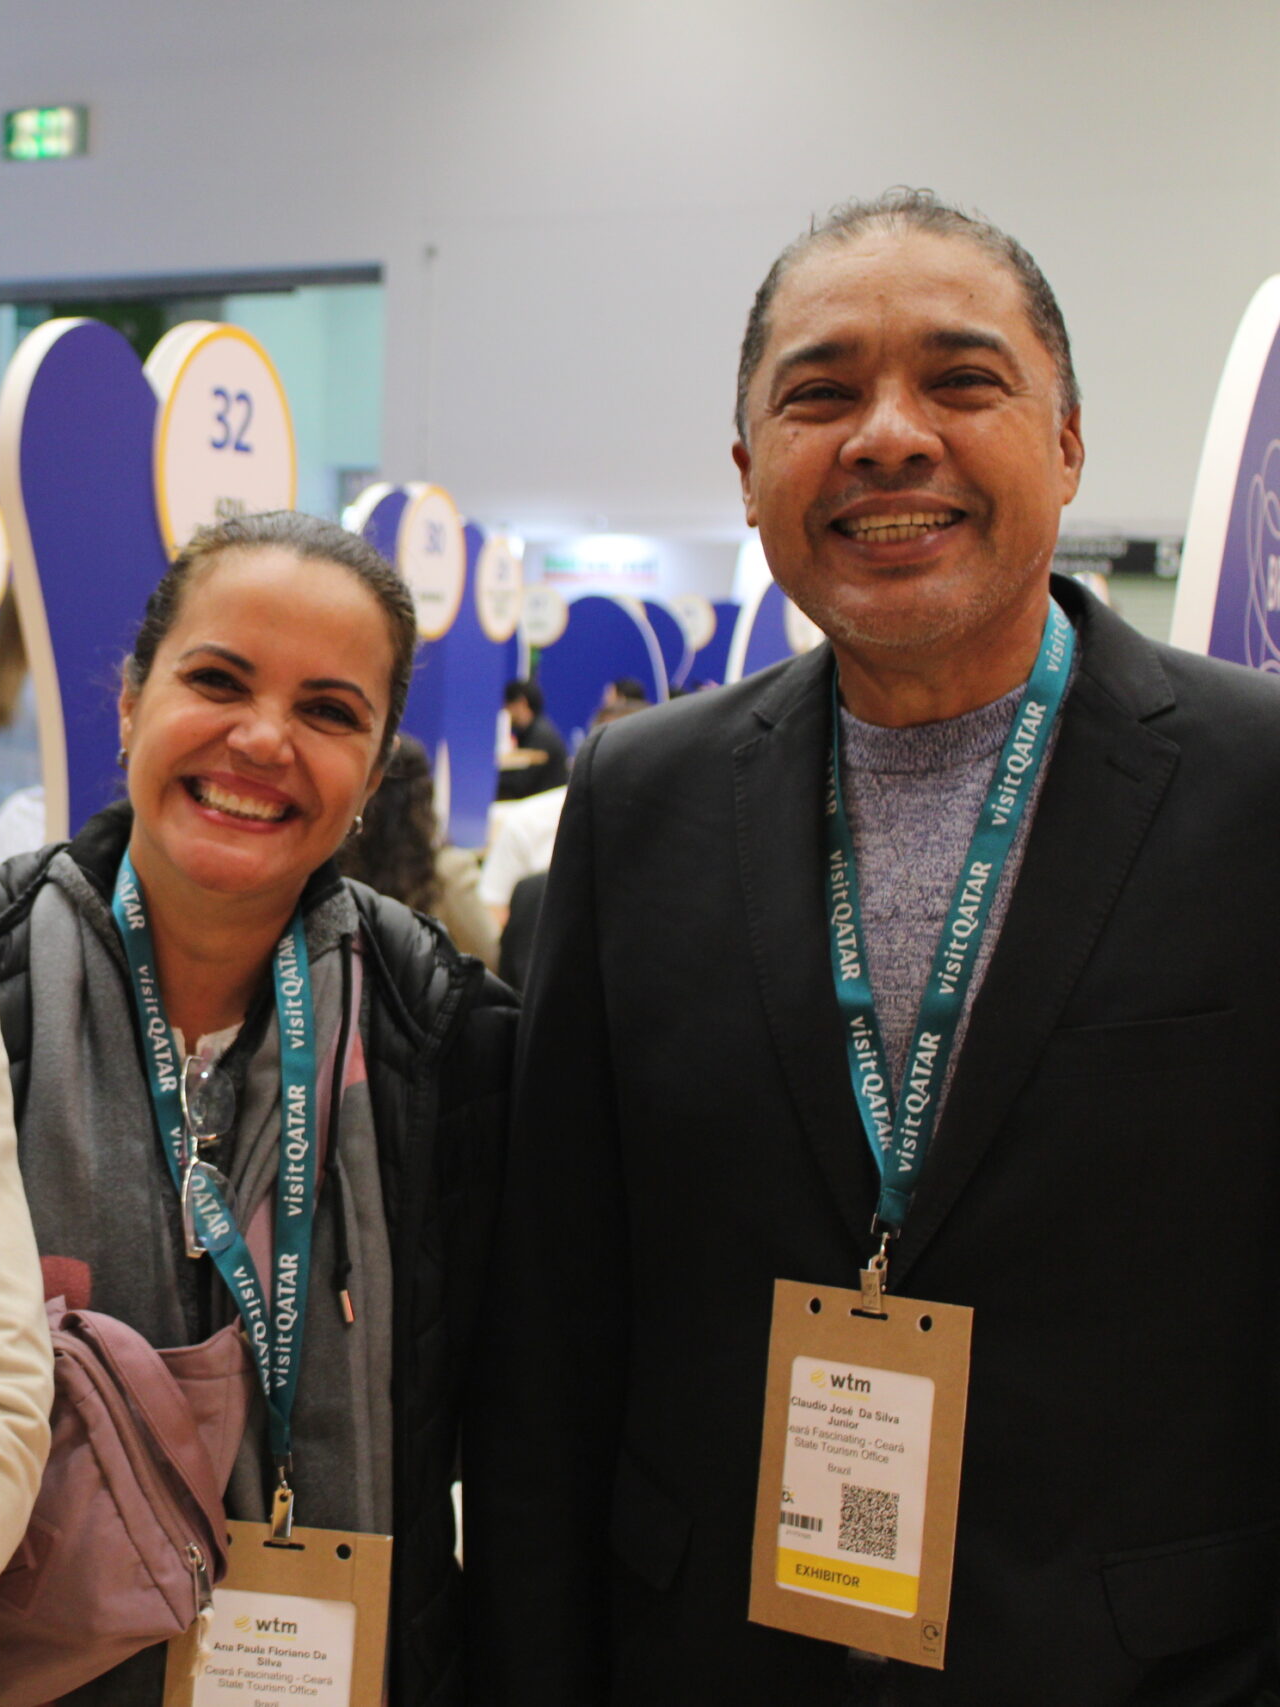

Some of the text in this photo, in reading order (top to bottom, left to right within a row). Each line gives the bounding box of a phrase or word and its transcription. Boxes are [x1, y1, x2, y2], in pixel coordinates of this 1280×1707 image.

[209, 387, 253, 453] 32
[991, 700, 1047, 827] visitQATAR
[829, 849, 861, 981] visitQATAR
[939, 860, 992, 996] visitQATAR
[138, 964, 178, 1093] visitQATAR
[898, 1030, 942, 1174] visitQATAR
[284, 1084, 306, 1217] visitQATAR
[272, 1253, 299, 1388] visitQATAR
[830, 1373, 871, 1393] wtm
[791, 1396, 828, 1412] Claudio
[830, 1404, 853, 1416] José
[859, 1408, 872, 1419] Da
[875, 1411, 900, 1425] Silva
[828, 1417, 859, 1430] Junior
[789, 1425, 810, 1435] eará
[812, 1426, 866, 1449] Fascinating
[874, 1438, 905, 1454] Ceará
[794, 1436, 890, 1464] State Tourism Office
[827, 1462, 852, 1476] Brazil
[795, 1564, 861, 1588] EXHIBITOR
[256, 1617, 298, 1635] wtm
[214, 1642, 328, 1660] Ana Paula Floriano Da
[257, 1657, 283, 1668] Silva
[204, 1665, 235, 1677] Ceará
[237, 1667, 294, 1683] Fascinating
[302, 1674, 334, 1686] Ceará
[218, 1678, 319, 1696] State Tourism Office
